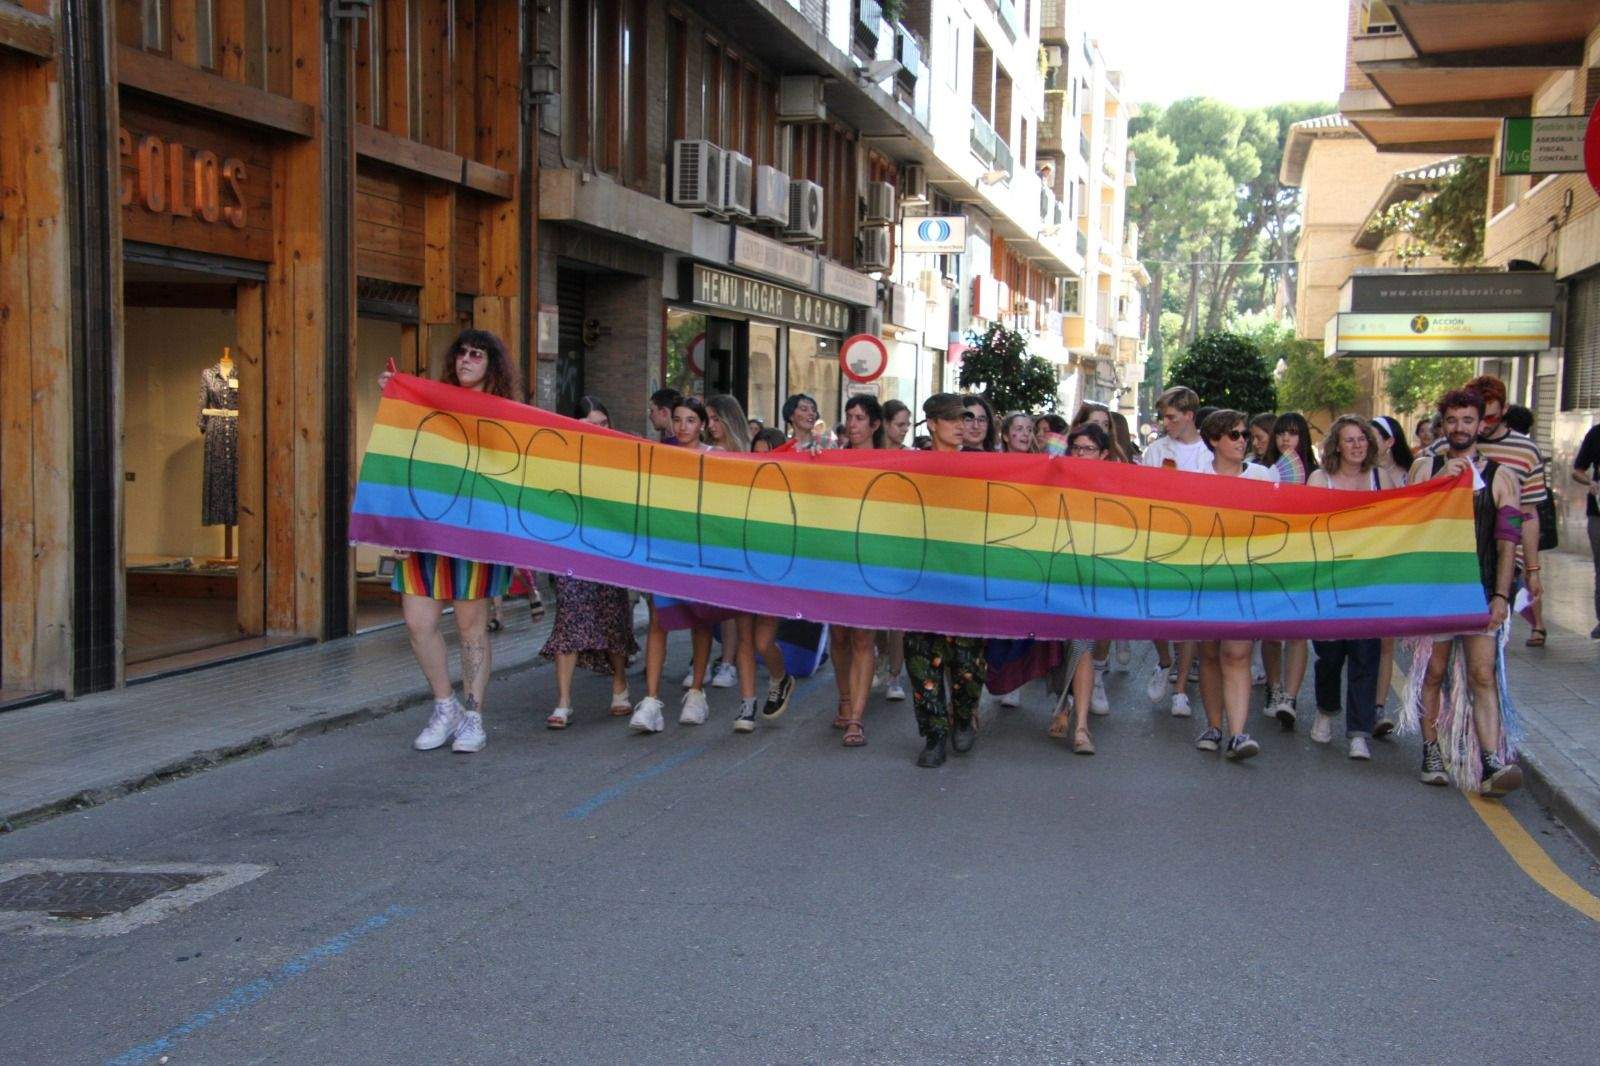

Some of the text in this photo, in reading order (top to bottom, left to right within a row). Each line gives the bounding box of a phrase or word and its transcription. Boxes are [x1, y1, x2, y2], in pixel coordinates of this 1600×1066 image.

[701, 269, 783, 315] HEMU HOGAR
[1380, 287, 1523, 297] www.accionlaboral.com
[407, 410, 1394, 619] ORGULLO O BARBARIE
